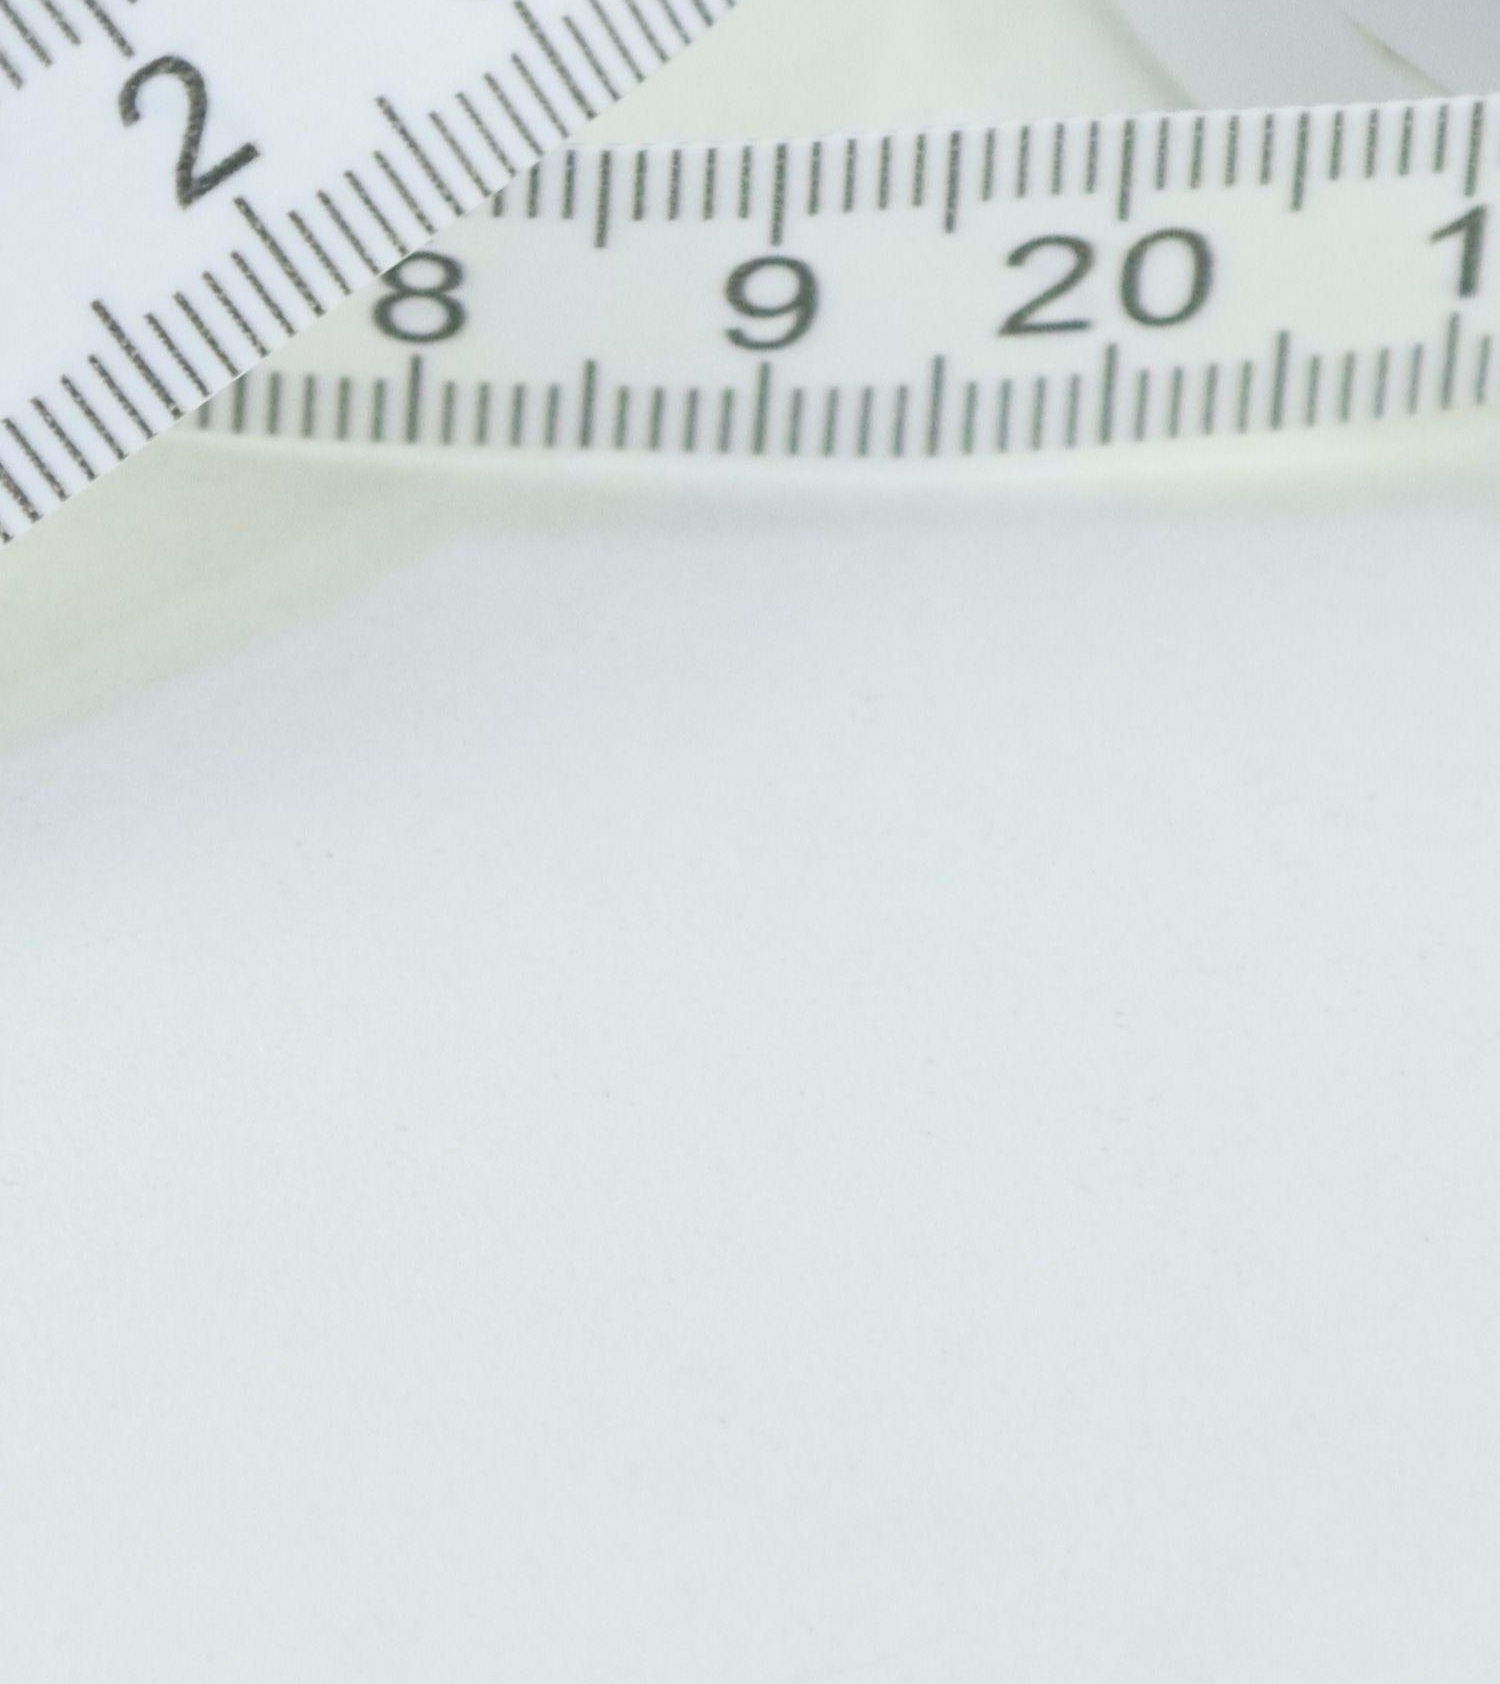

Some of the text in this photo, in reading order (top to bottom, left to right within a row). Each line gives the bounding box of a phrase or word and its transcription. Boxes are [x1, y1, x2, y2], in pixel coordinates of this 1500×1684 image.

[110, 52, 267, 208] 2
[372, 252, 468, 344] 8
[722, 254, 820, 350] 9
[998, 226, 1215, 338] 20
[1425, 204, 1492, 301] 1
